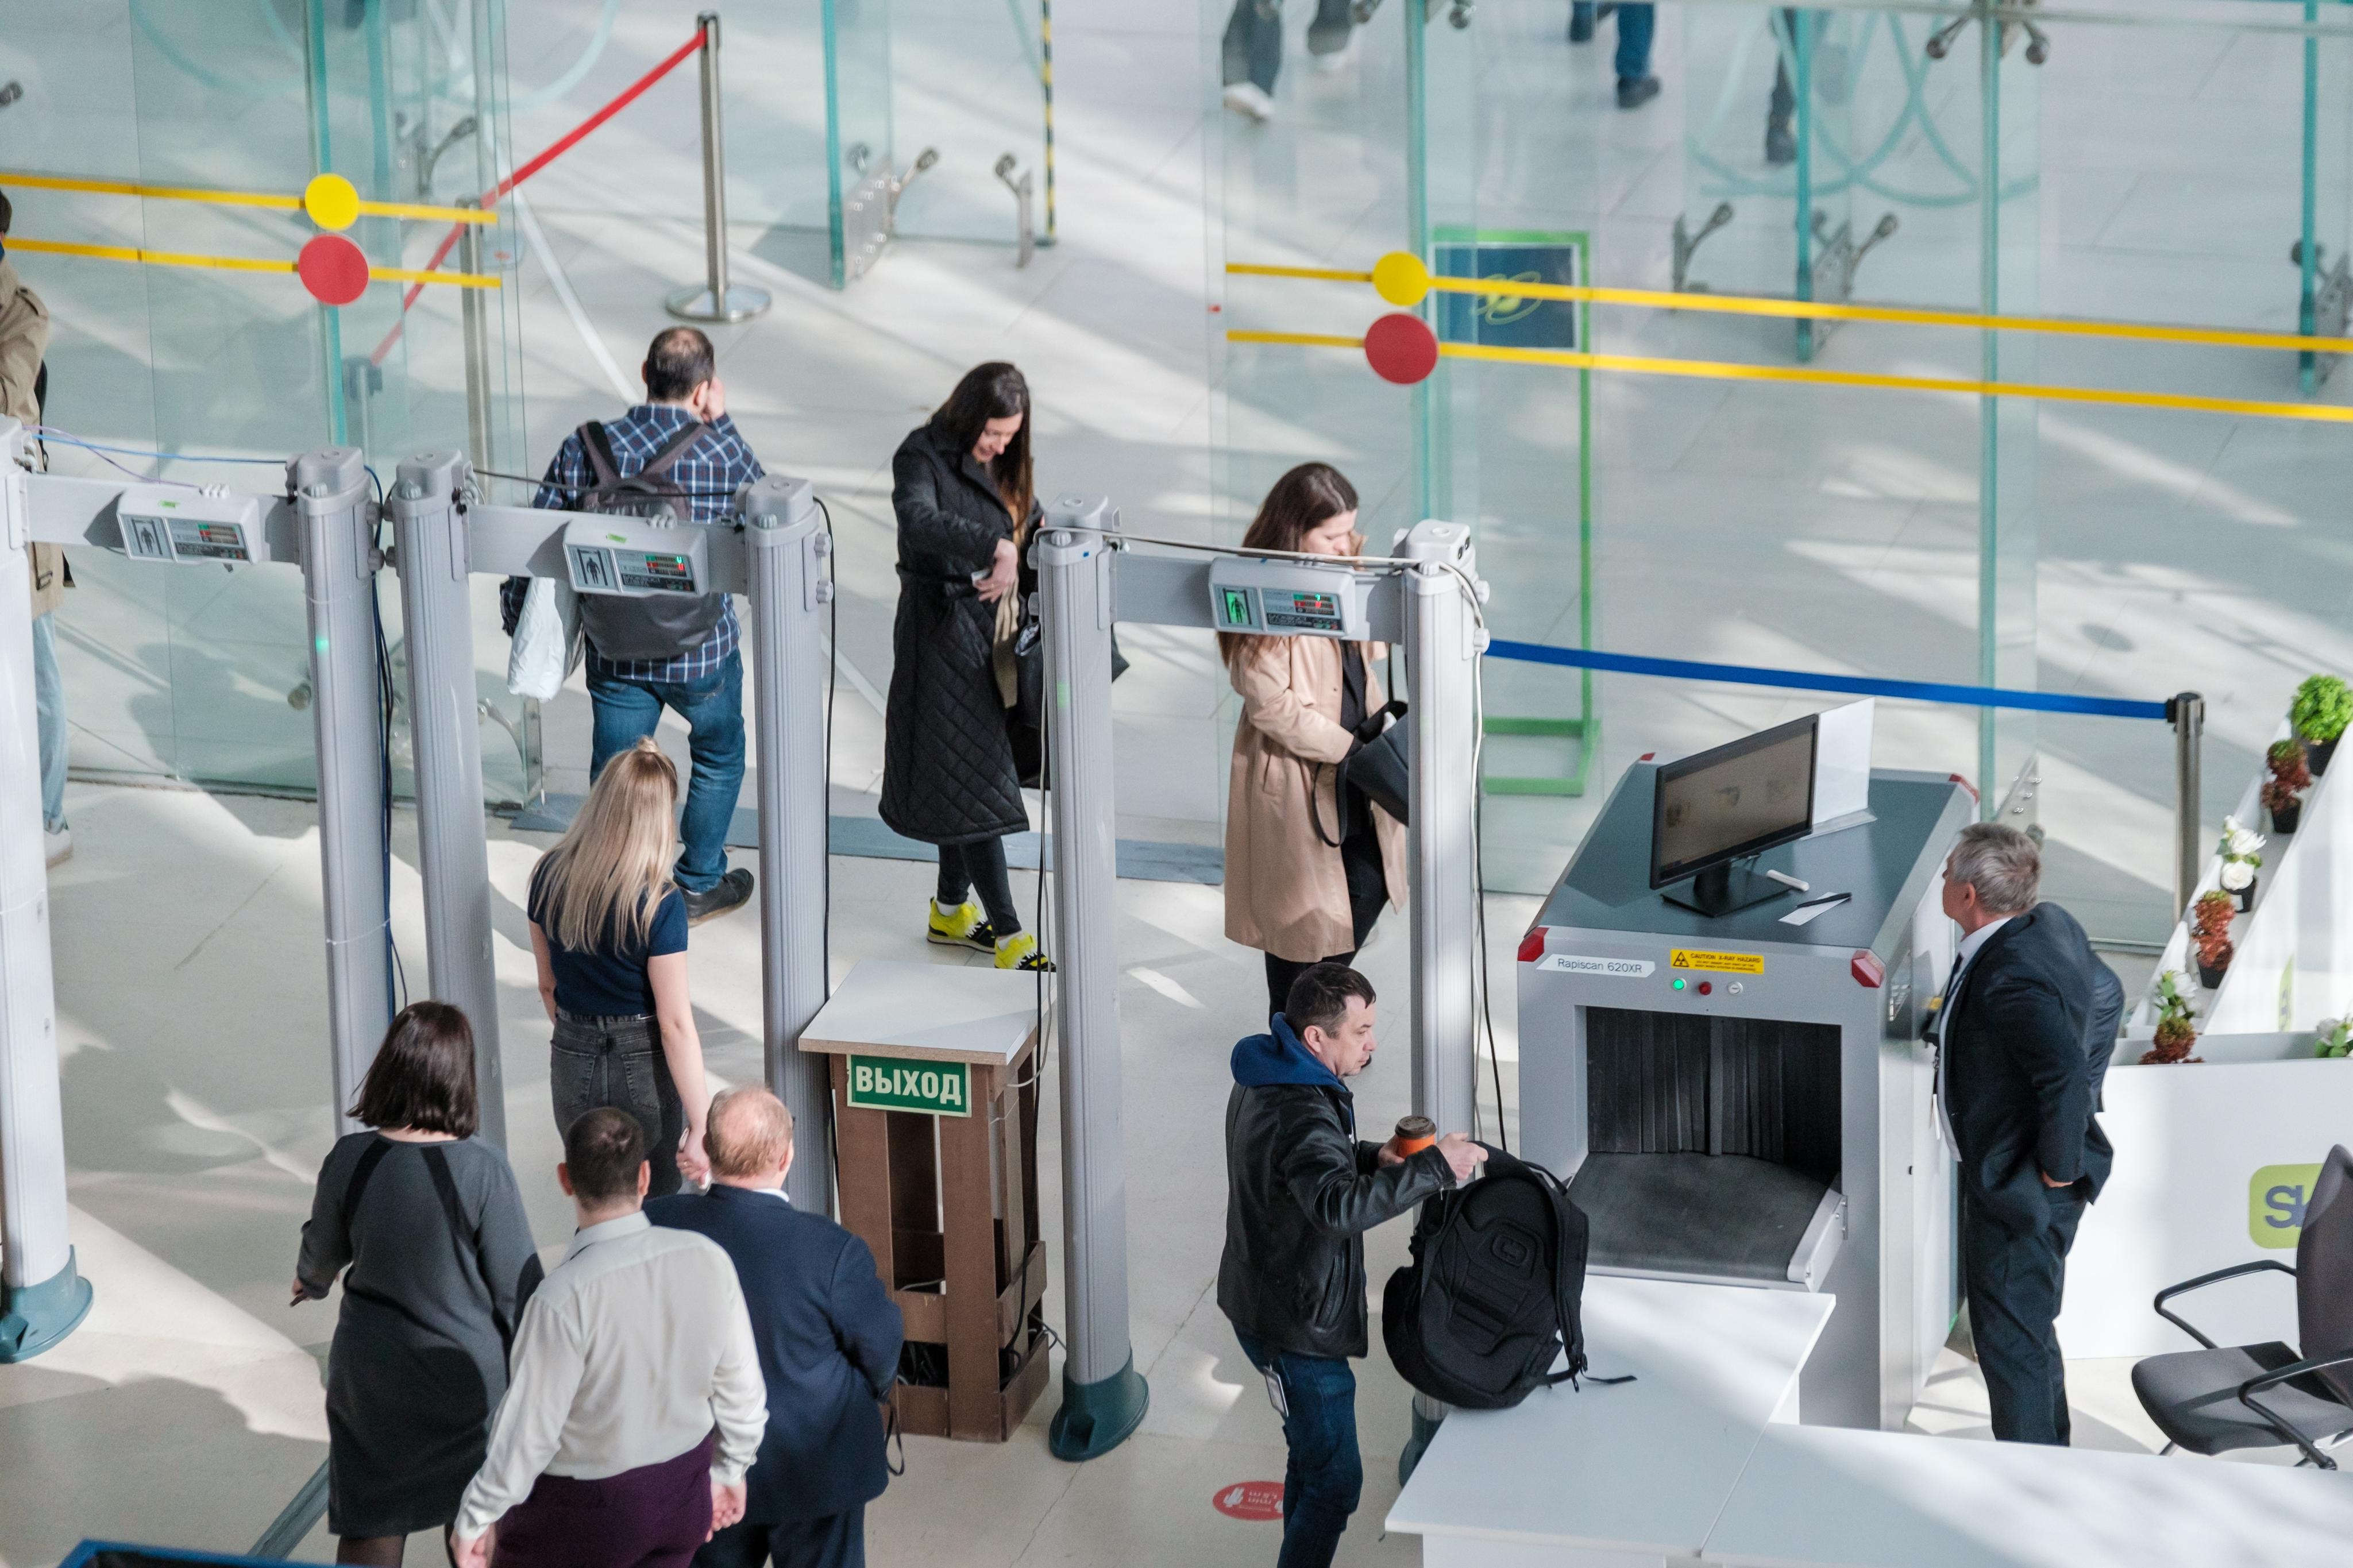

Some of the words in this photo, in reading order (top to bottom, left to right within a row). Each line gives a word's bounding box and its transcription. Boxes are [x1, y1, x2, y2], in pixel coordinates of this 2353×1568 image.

[1557, 958, 1604, 970] Rapiscan
[1607, 962, 1642, 973] 620XR
[856, 1065, 962, 1106] ВЫХОД
